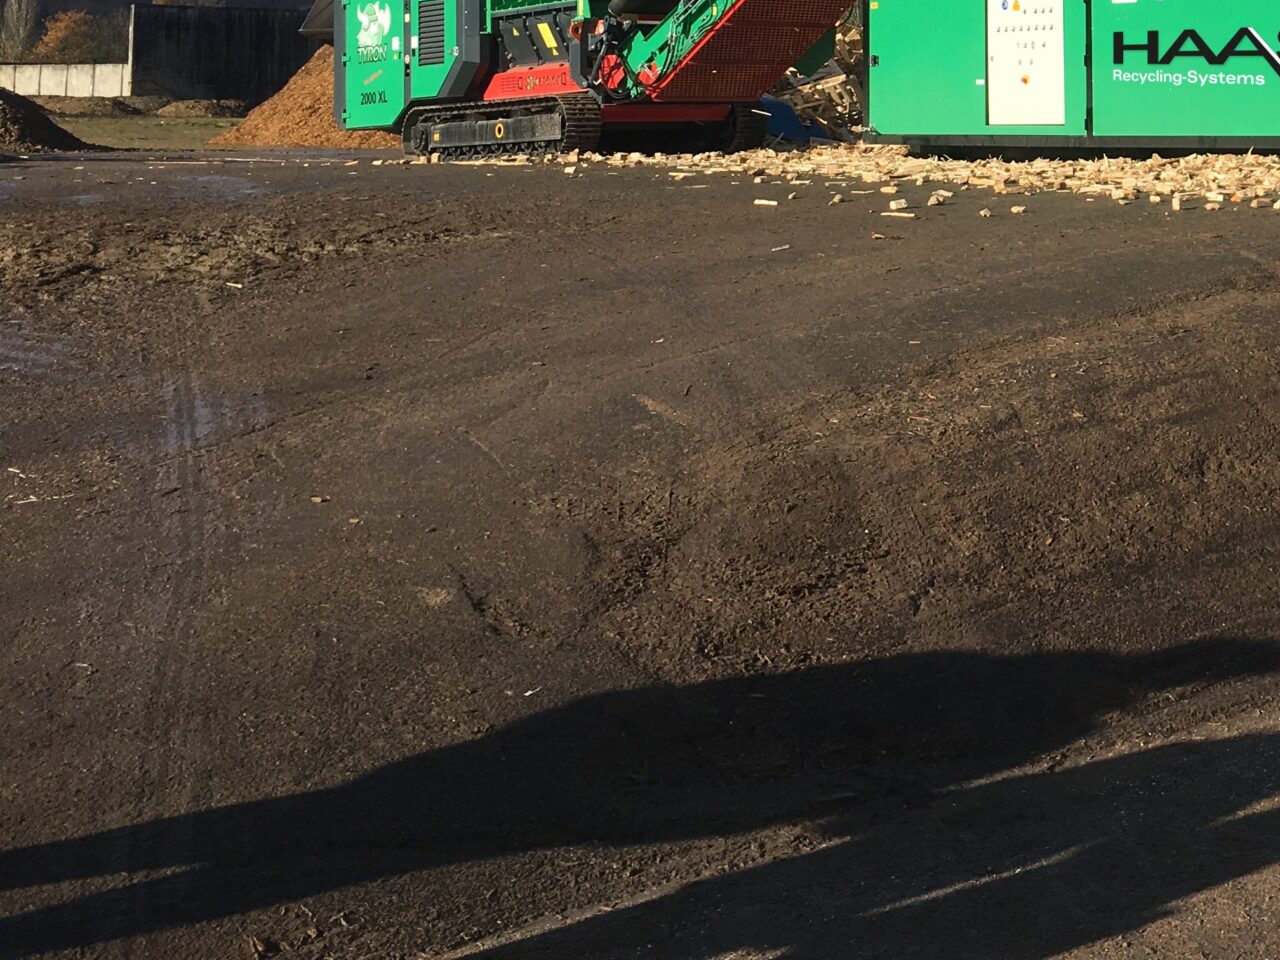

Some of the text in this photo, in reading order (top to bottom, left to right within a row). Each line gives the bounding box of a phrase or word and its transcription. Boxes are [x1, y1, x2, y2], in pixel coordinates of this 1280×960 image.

[357, 44, 387, 64] TYRON
[1113, 69, 1265, 86] Recycling-Systems
[360, 91, 388, 105] 2000 XL
